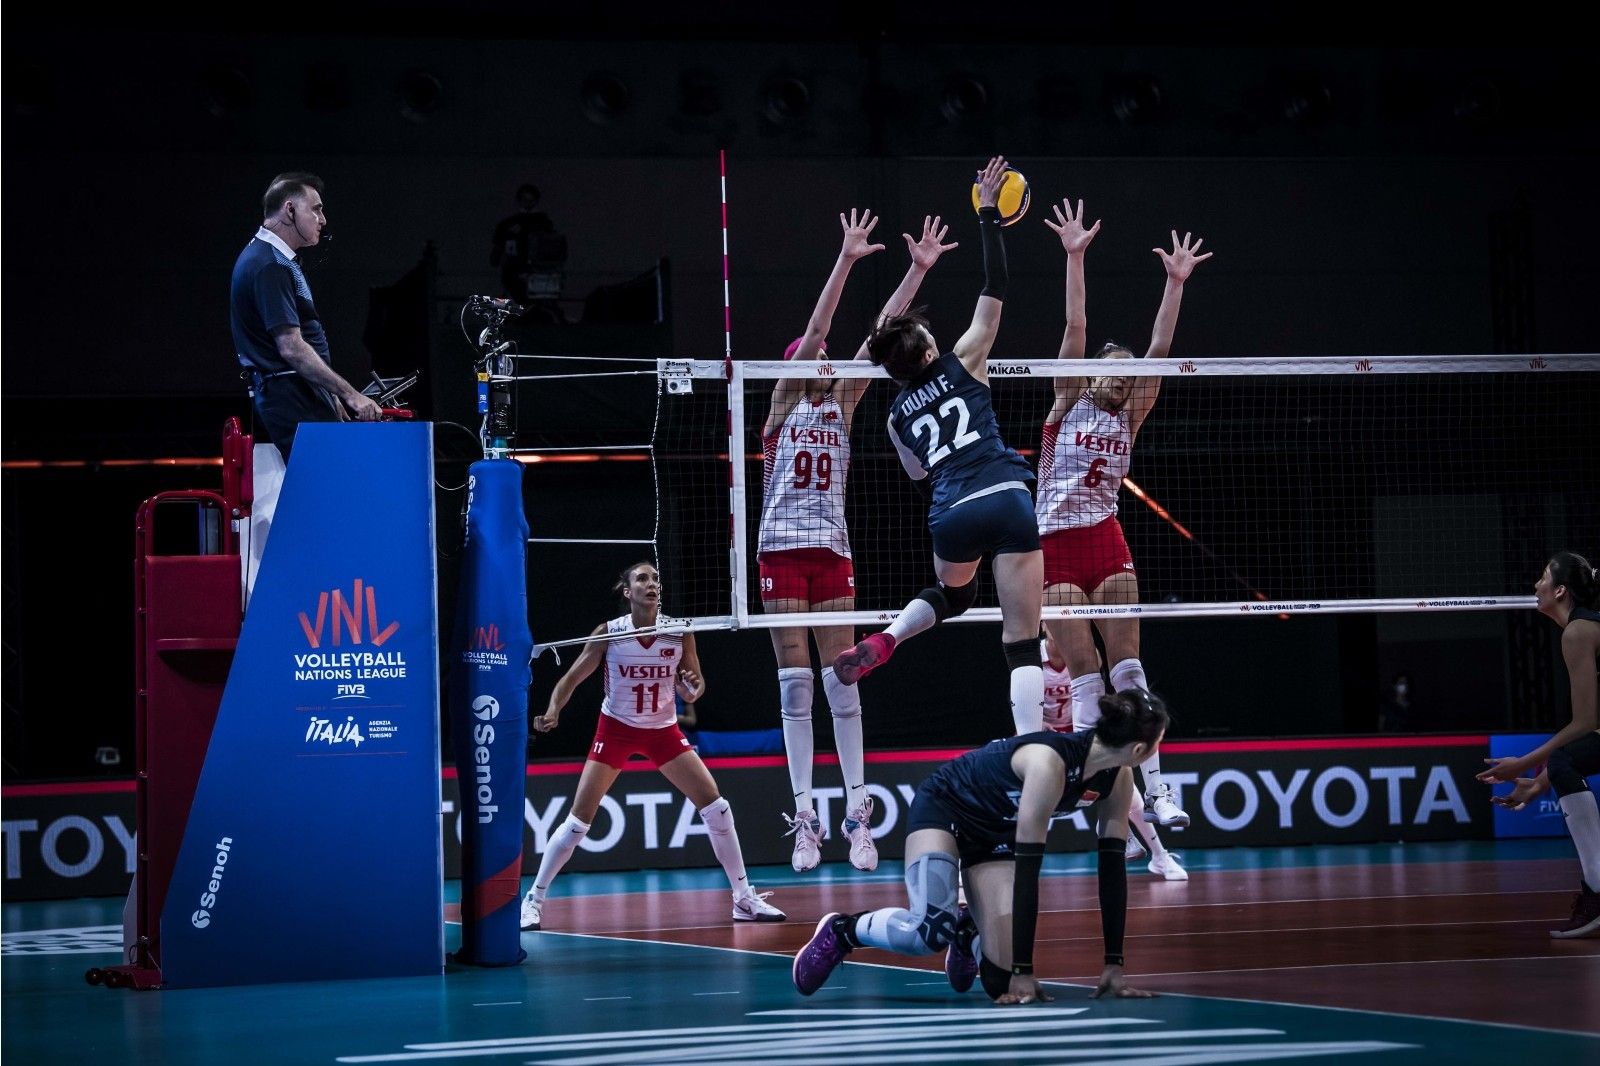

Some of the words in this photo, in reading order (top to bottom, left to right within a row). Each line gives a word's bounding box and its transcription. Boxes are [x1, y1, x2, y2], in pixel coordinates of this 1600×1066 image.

[817, 363, 836, 376] VNL
[1178, 360, 1197, 373] VNL
[1355, 359, 1373, 372] VNL
[1529, 356, 1547, 369] VNL
[901, 380, 941, 417] DUAN
[911, 396, 982, 468] 22
[1075, 430, 1128, 456] VESTEL
[793, 450, 832, 491] 99
[1084, 457, 1108, 488] 6
[297, 577, 401, 649] VNL
[293, 652, 406, 668] VOLLEYBALL
[618, 664, 673, 679] VESTEL
[295, 669, 352, 681] NATIONS
[356, 668, 407, 679] LEAGUE
[631, 682, 660, 714] 11
[1044, 684, 1072, 697] EST
[1056, 698, 1069, 719] 7
[593, 741, 605, 754] 11
[473, 724, 499, 824] Senoh
[1162, 764, 1473, 832] TOYOTA
[1539, 800, 1561, 813] FIV
[0, 813, 138, 880] TOY
[201, 836, 233, 909] Senoh
